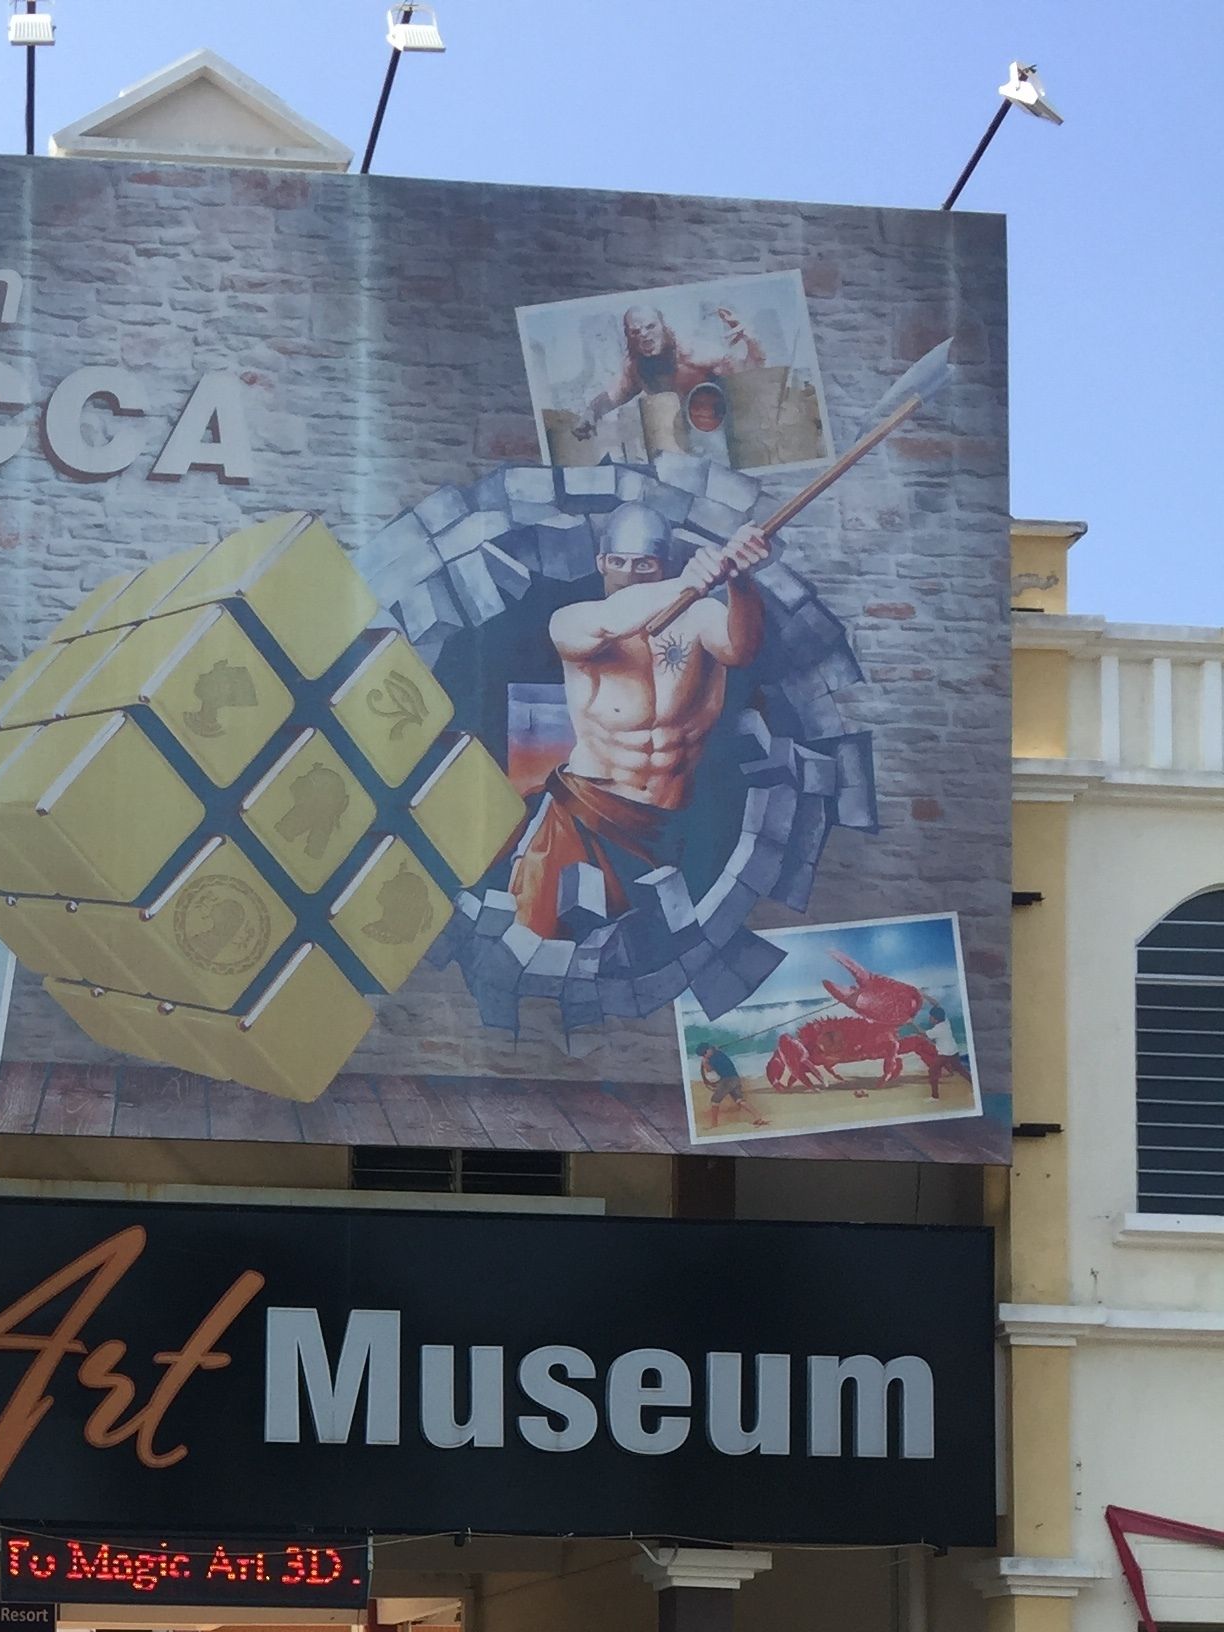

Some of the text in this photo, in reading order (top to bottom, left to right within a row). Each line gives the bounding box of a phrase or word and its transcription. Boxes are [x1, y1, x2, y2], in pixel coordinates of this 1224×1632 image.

[264, 1306, 935, 1459] Museum
[66, 1540, 191, 1590] Magic
[207, 1545, 270, 1581] Art
[1, 1607, 49, 1622] Resort
